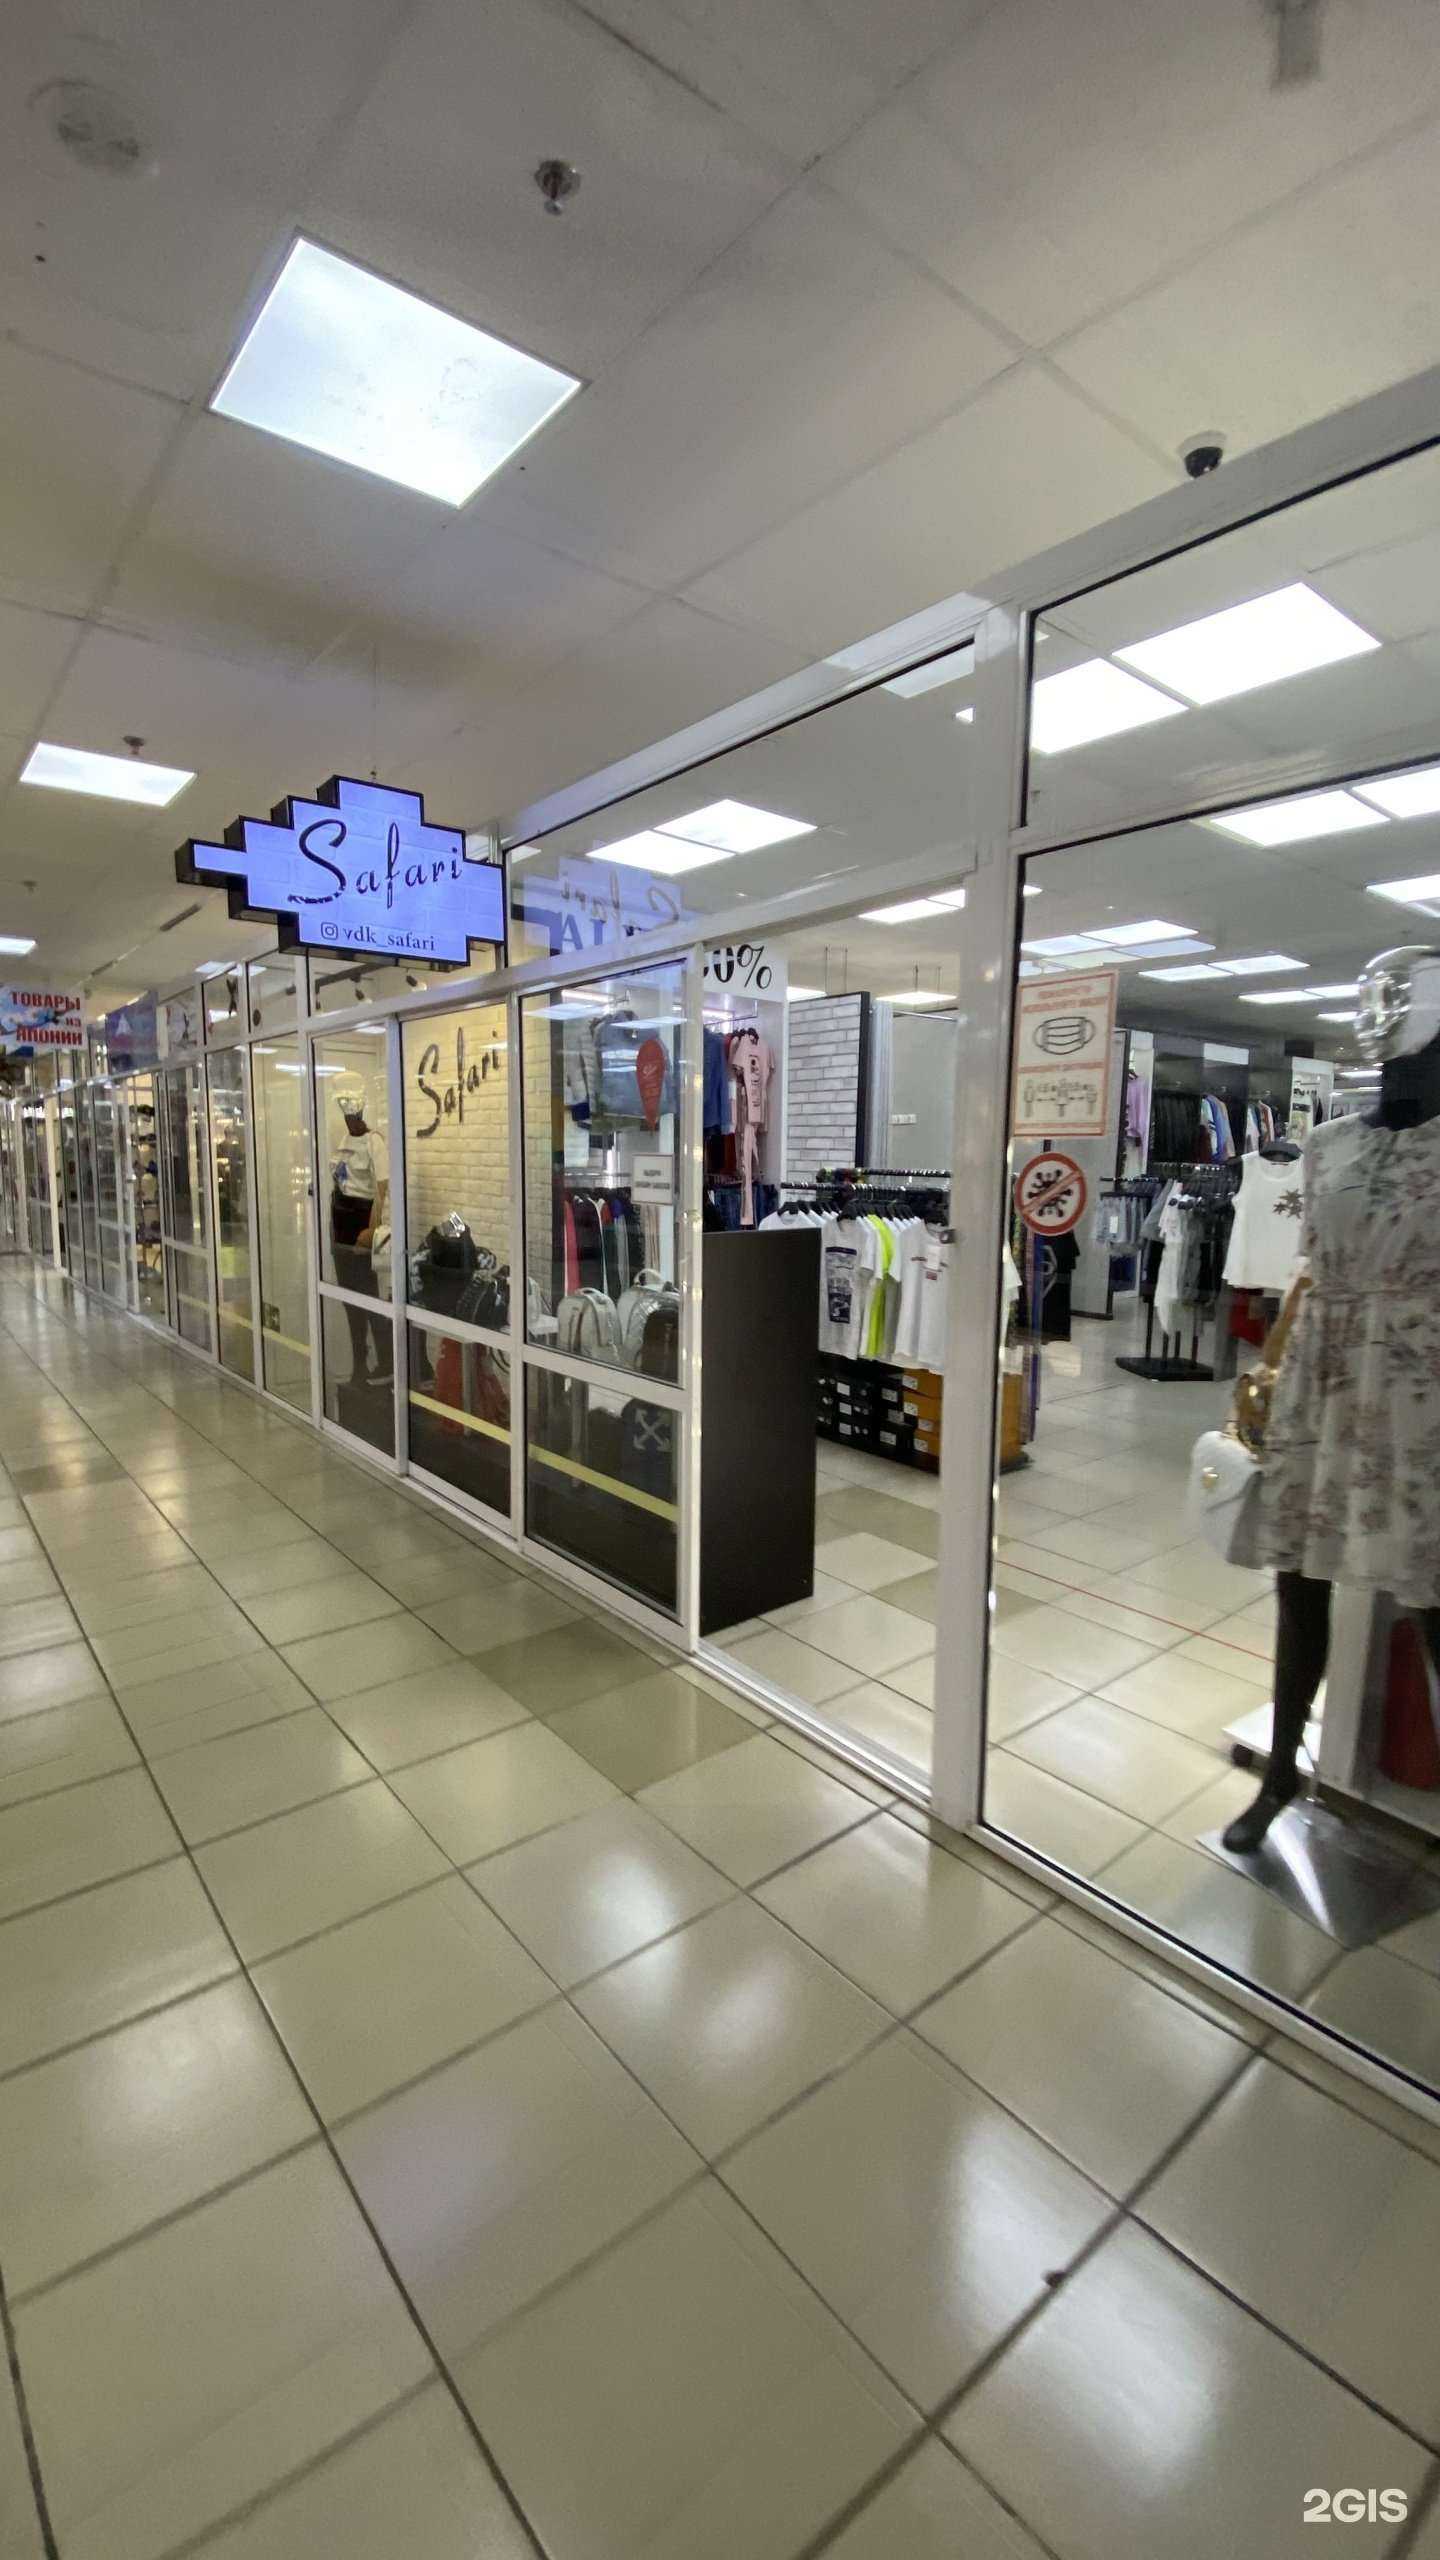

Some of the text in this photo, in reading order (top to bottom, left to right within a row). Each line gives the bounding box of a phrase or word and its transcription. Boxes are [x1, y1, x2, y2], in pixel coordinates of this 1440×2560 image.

[288, 819, 462, 909] Safari
[343, 926, 436, 951] vdk_safari
[12, 991, 81, 1011] ТОВАРЫ
[16, 1027, 82, 1045] ЯПОНИИ
[416, 1026, 499, 1137] Safari
